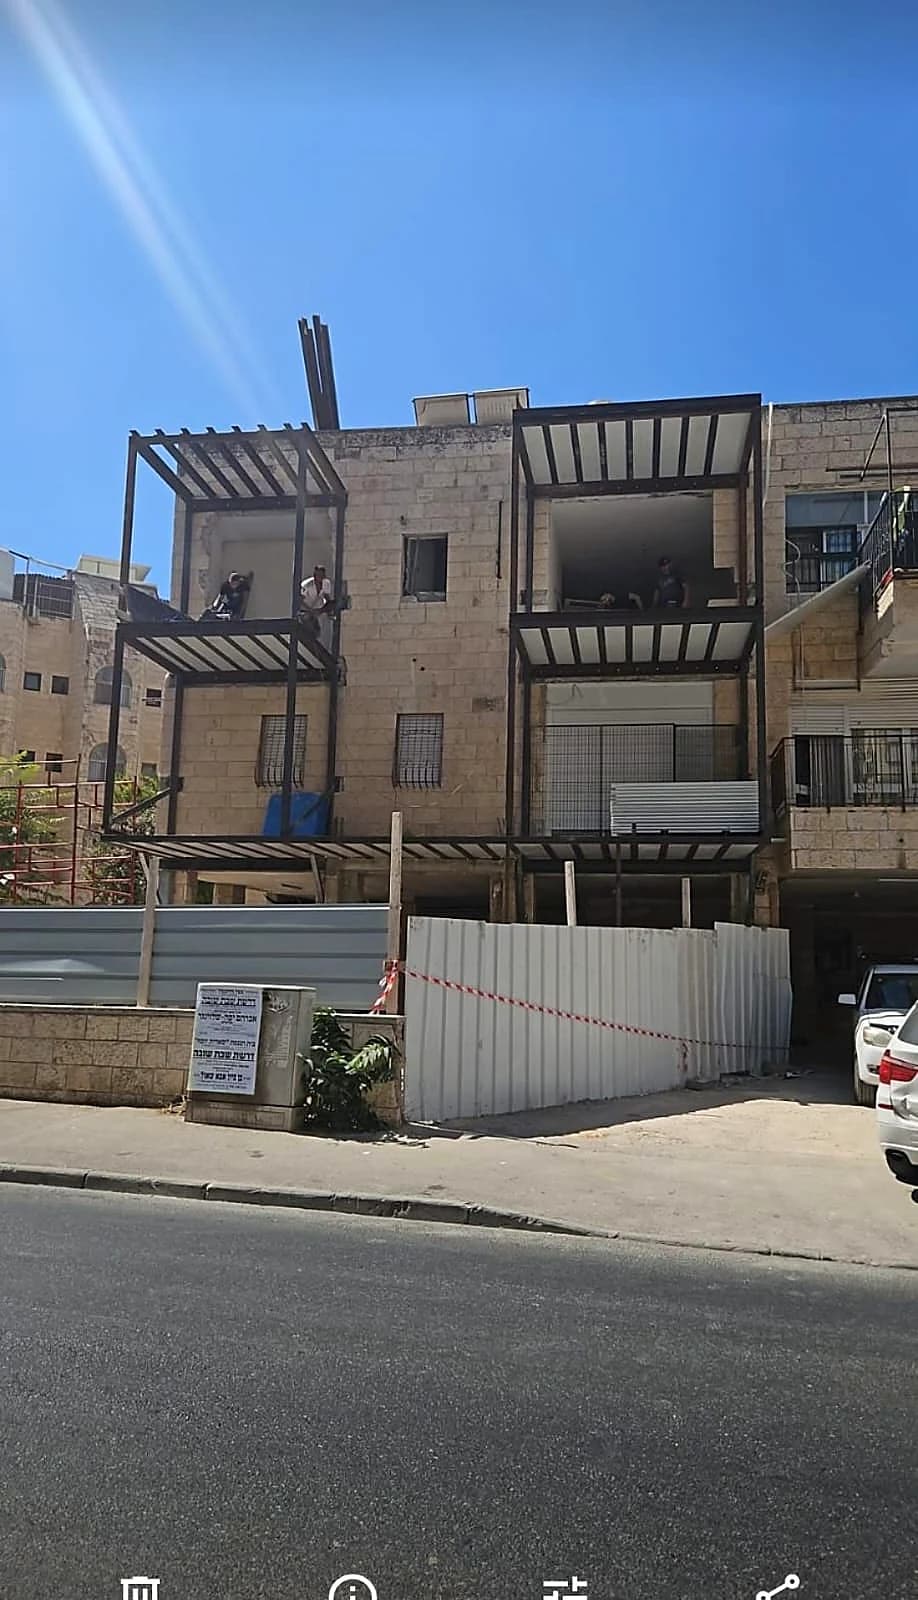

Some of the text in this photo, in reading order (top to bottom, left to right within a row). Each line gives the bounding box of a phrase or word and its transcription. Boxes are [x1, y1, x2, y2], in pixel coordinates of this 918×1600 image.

[193, 1049, 257, 1060] דרשת שבת שובה
